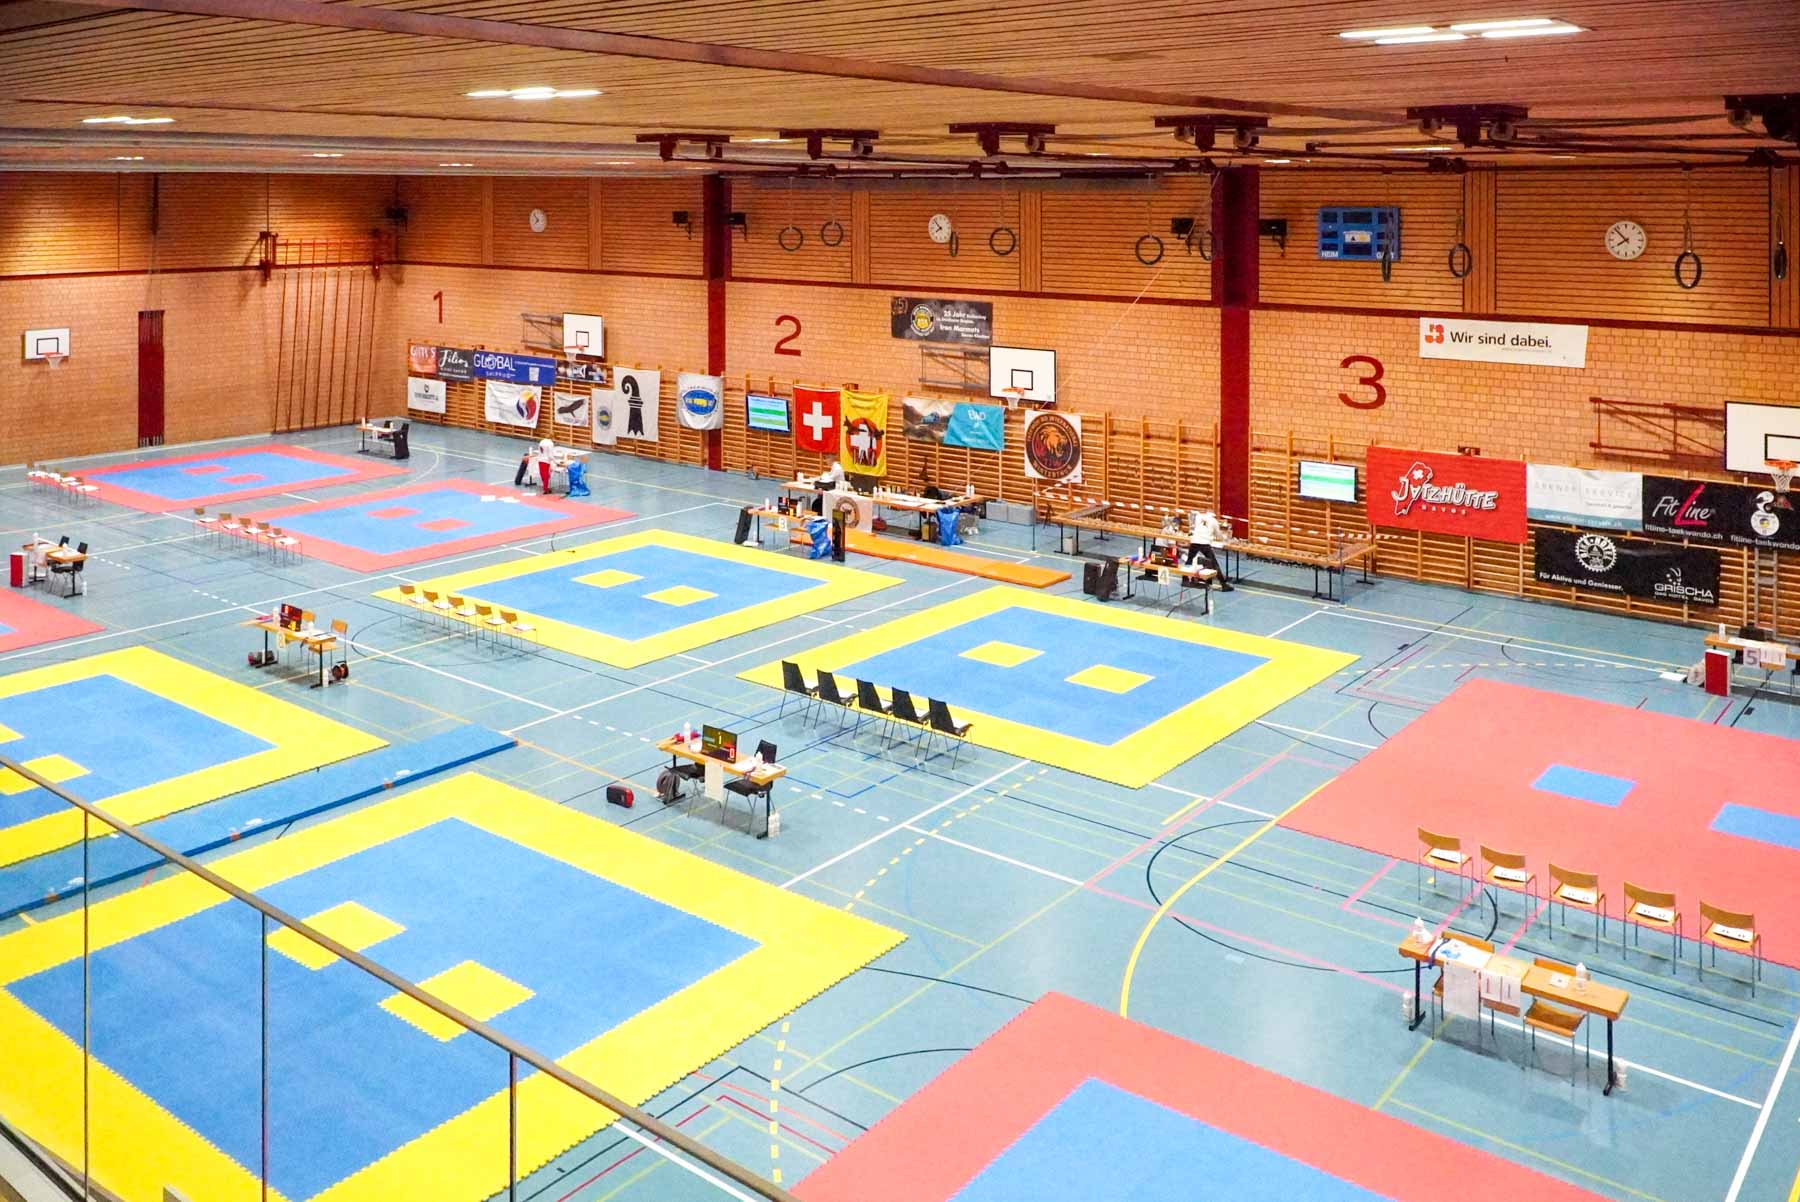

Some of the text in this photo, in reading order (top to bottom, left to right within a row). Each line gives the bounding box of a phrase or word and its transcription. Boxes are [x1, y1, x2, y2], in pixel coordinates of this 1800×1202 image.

[1321, 250, 1339, 258] HEIM
[433, 291, 443, 323] 1
[775, 315, 802, 356] 2
[1450, 331, 1552, 348] Wir sind dabei.
[1338, 355, 1387, 409] 3
[1539, 571, 1550, 579] Für
[1654, 582, 1714, 599] GRISCHA
[1747, 650, 1758, 665] 5
